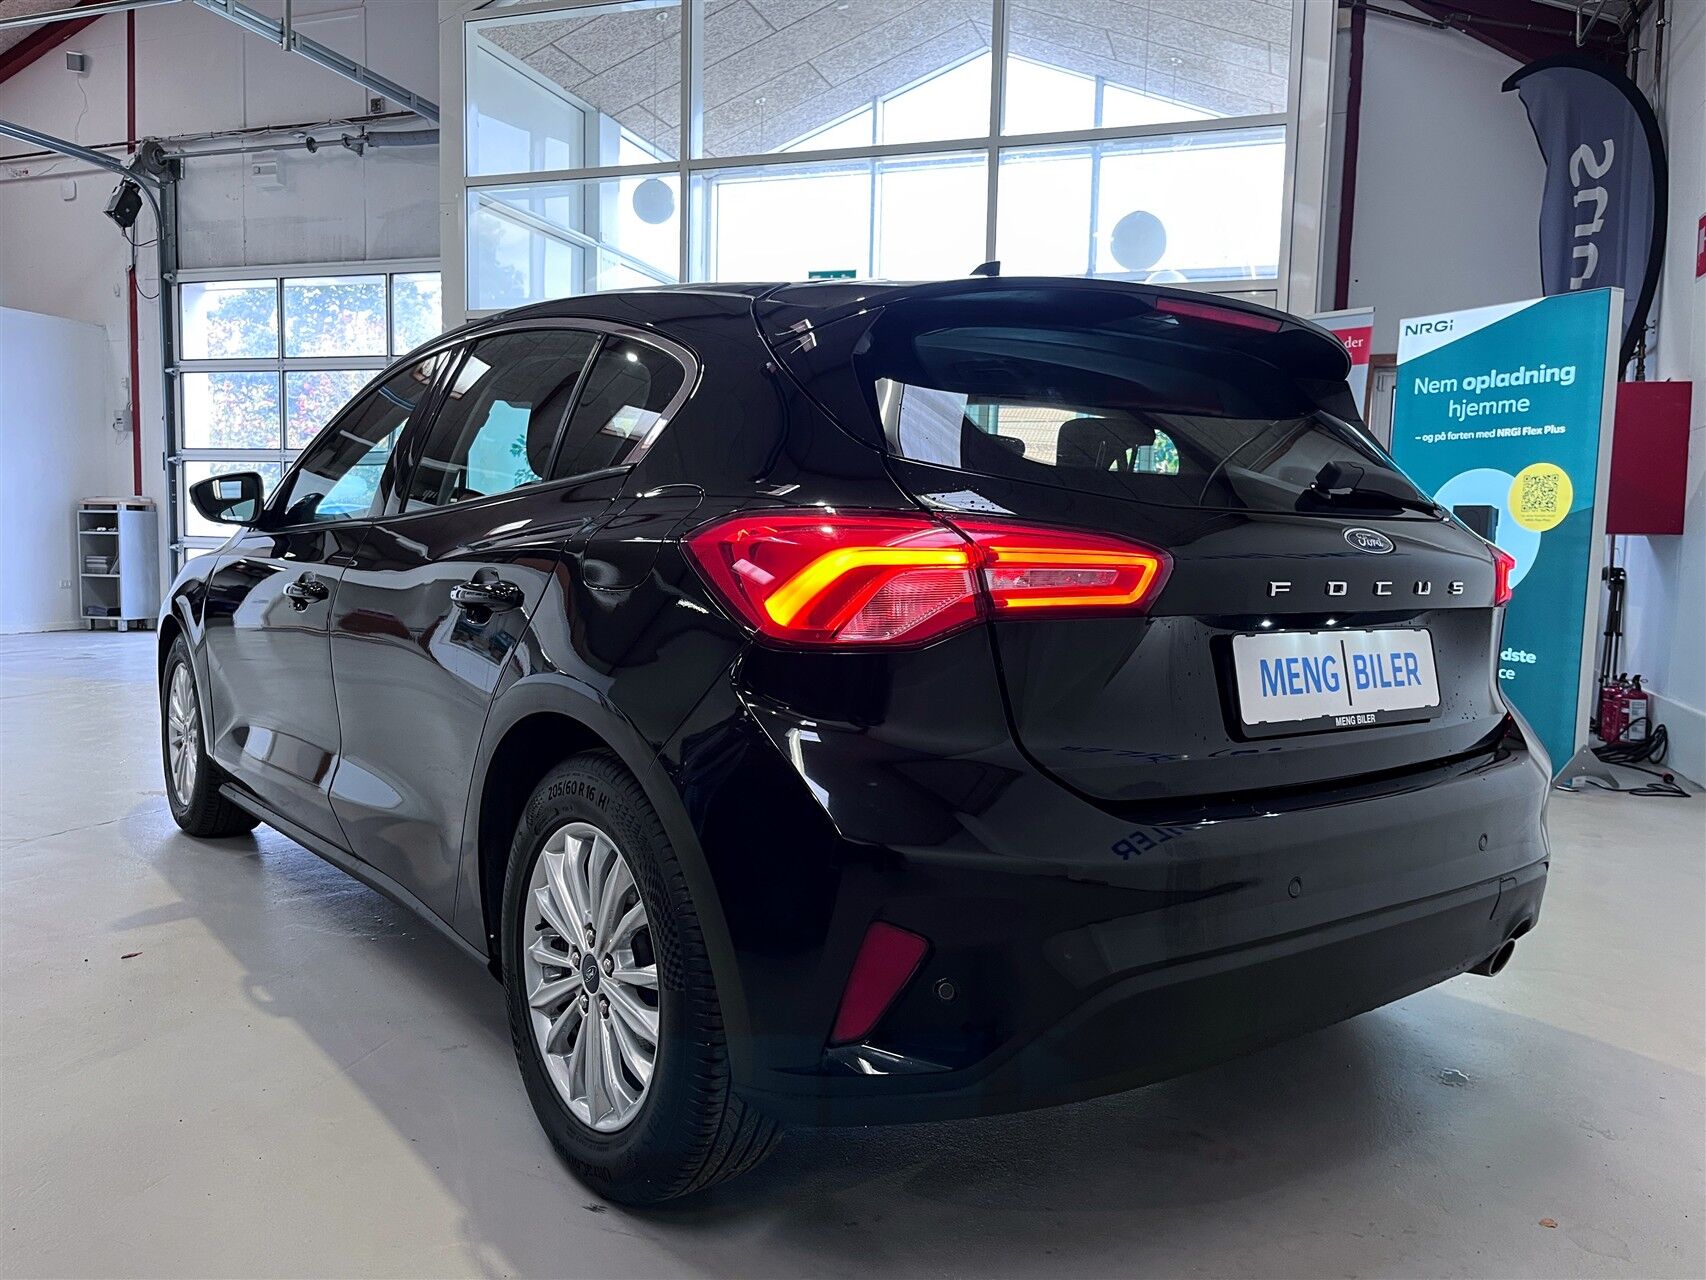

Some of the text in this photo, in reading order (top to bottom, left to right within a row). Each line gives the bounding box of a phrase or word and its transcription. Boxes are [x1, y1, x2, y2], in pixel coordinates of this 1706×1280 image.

[1405, 319, 1454, 337] NRGi
[1344, 335, 1364, 349] der
[1414, 363, 1577, 395] Nem opladning
[1448, 397, 1531, 422] hjemme
[1421, 434, 1434, 444] og
[1434, 431, 1447, 443] på
[1475, 428, 1496, 439] med
[1522, 426, 1543, 436] Flex
[1543, 424, 1566, 435] Plus
[1355, 532, 1385, 548] Ford
[1269, 580, 1465, 597] FOCUS
[1500, 647, 1537, 664] dste
[1259, 651, 1423, 698] MENG BILER
[1498, 668, 1516, 680] ce
[1335, 713, 1377, 727] MENG BILER
[547, 780, 577, 801] 205/60
